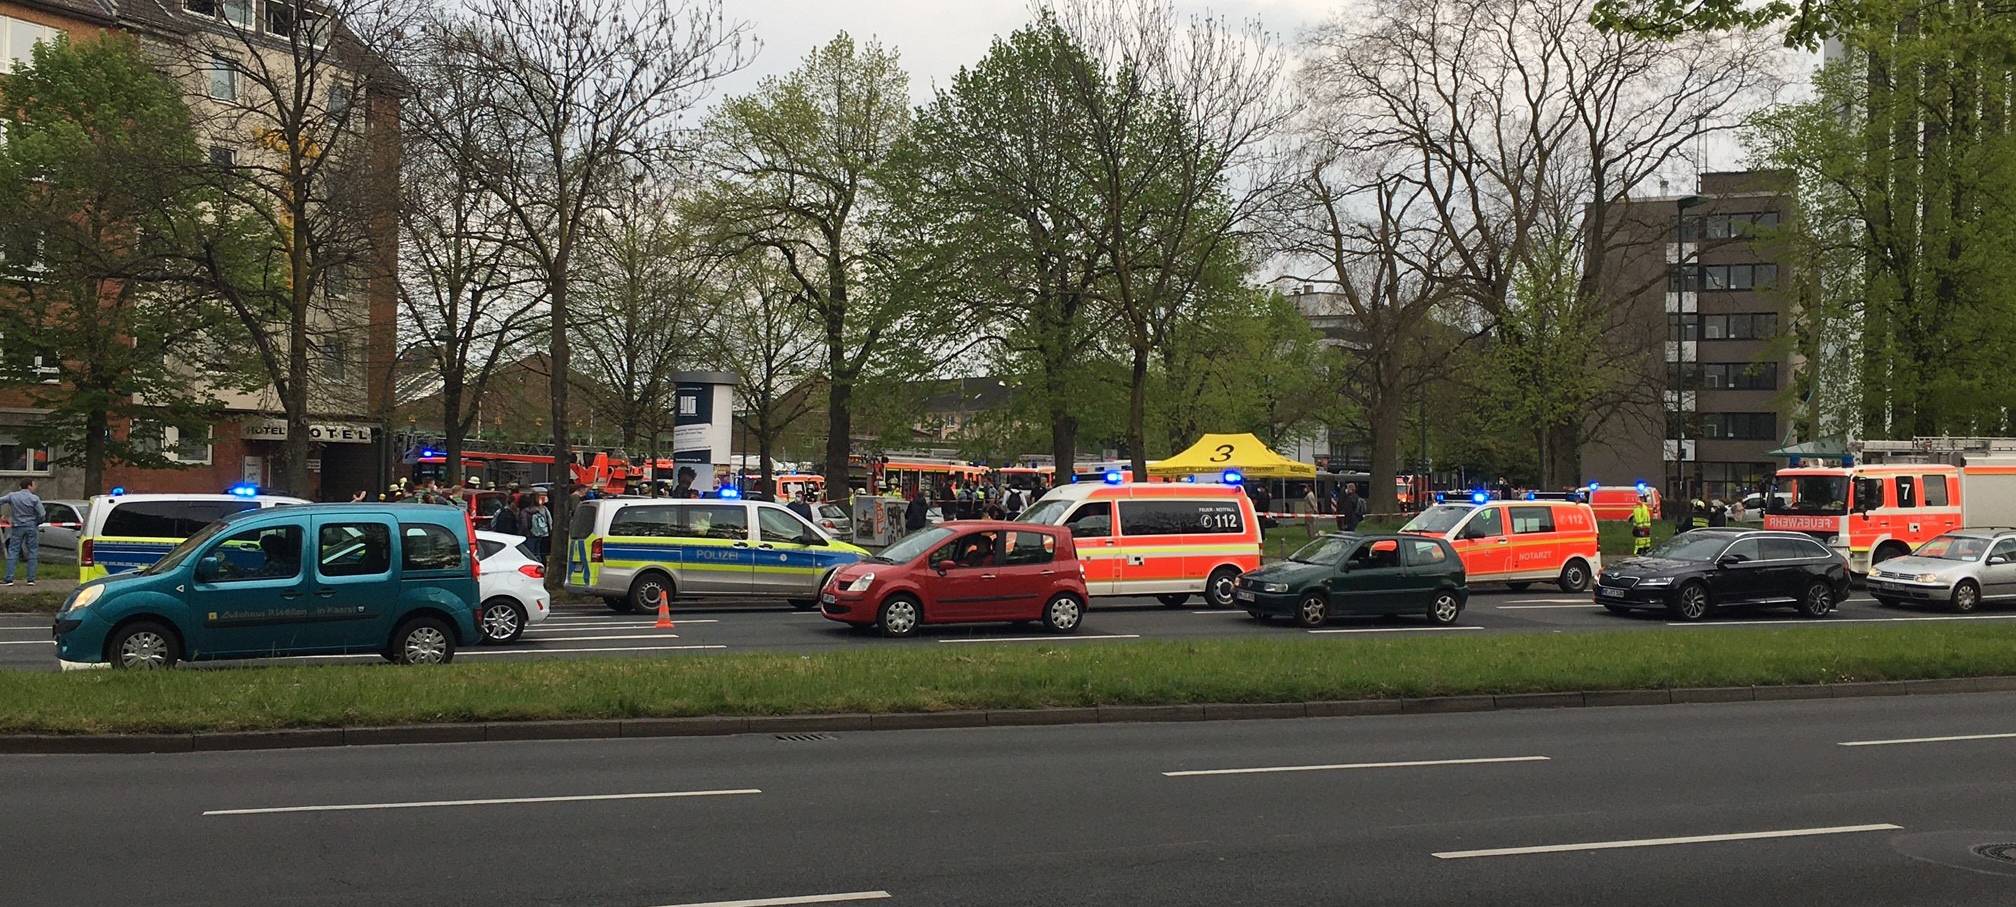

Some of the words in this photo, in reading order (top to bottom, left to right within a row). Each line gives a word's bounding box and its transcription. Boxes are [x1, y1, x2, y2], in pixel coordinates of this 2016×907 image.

[247, 425, 285, 435] HOTEL
[310, 428, 367, 440] OTEL
[1210, 444, 1235, 462] 3
[1901, 483, 1911, 500] 7
[1215, 514, 1237, 528] 112
[1568, 514, 1584, 525] 112
[696, 550, 738, 560] POLIZEI
[1519, 551, 1553, 560] NOTARZT
